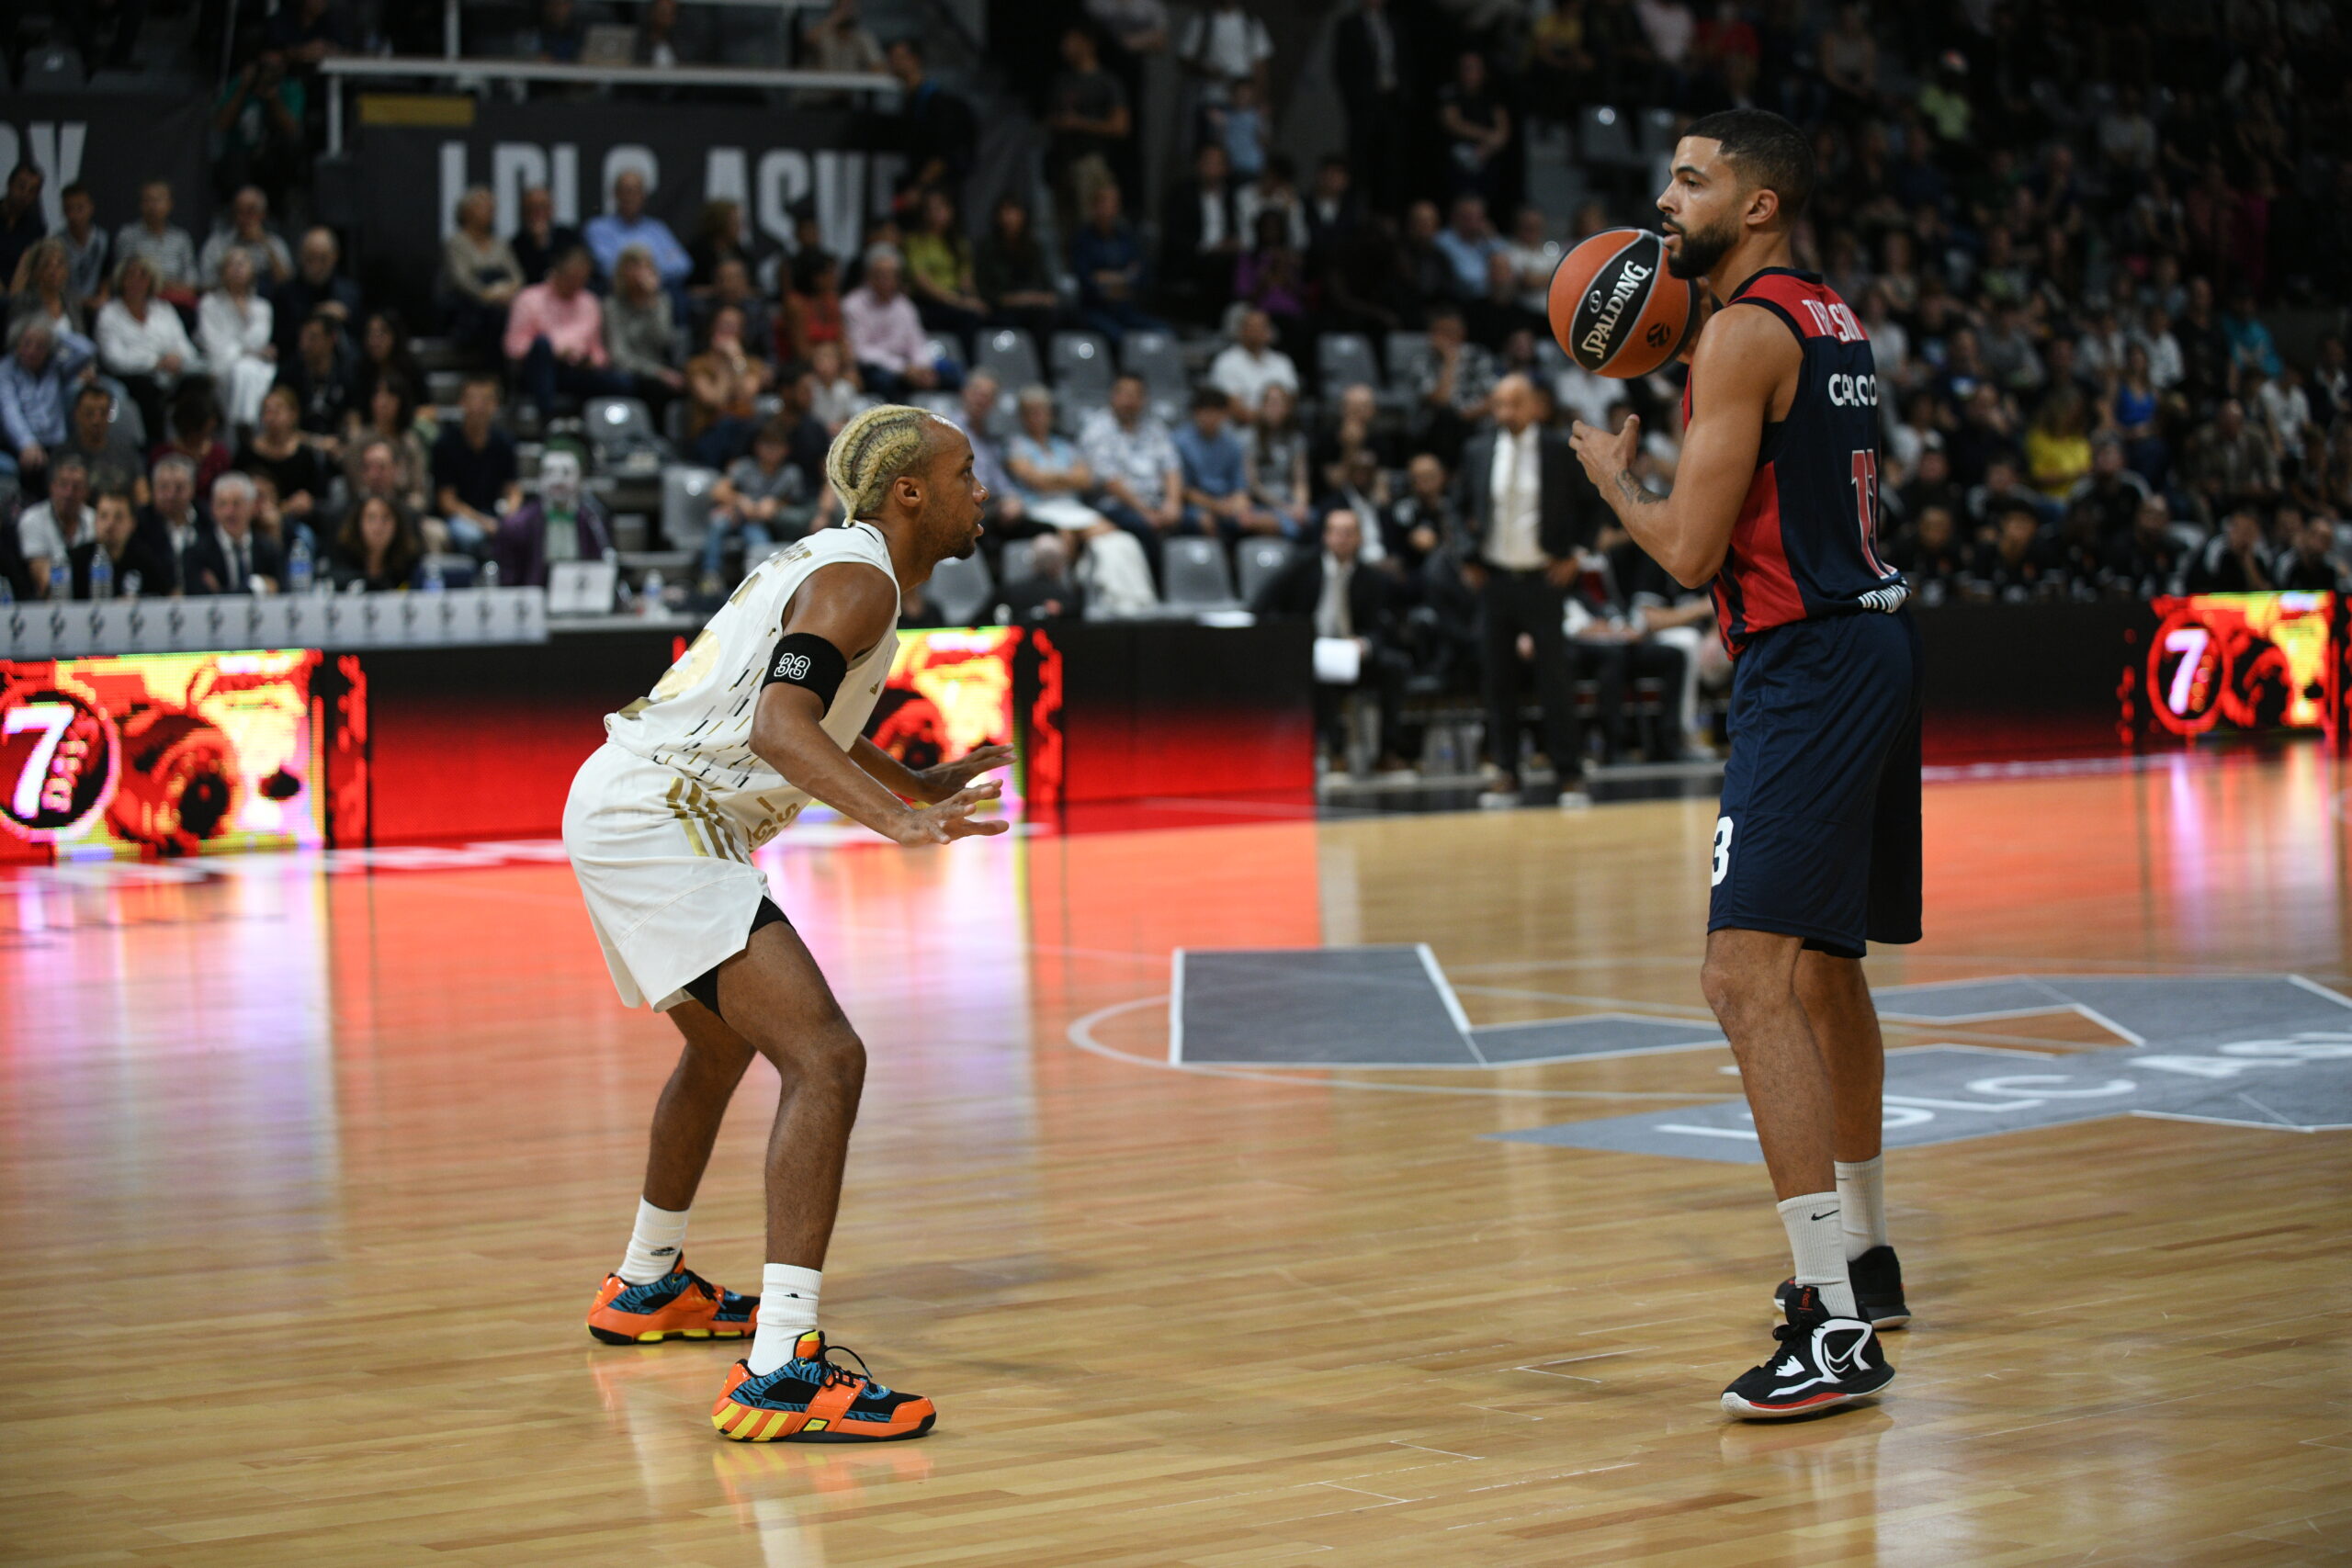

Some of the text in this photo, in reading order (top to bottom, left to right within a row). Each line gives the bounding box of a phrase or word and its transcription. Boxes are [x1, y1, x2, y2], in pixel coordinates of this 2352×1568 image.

[1581, 260, 1650, 359] SPALDING
[1827, 373, 1878, 407] CAOO
[774, 652, 810, 680] 33
[2165, 628, 2209, 714] 7
[4, 702, 75, 818] 7
